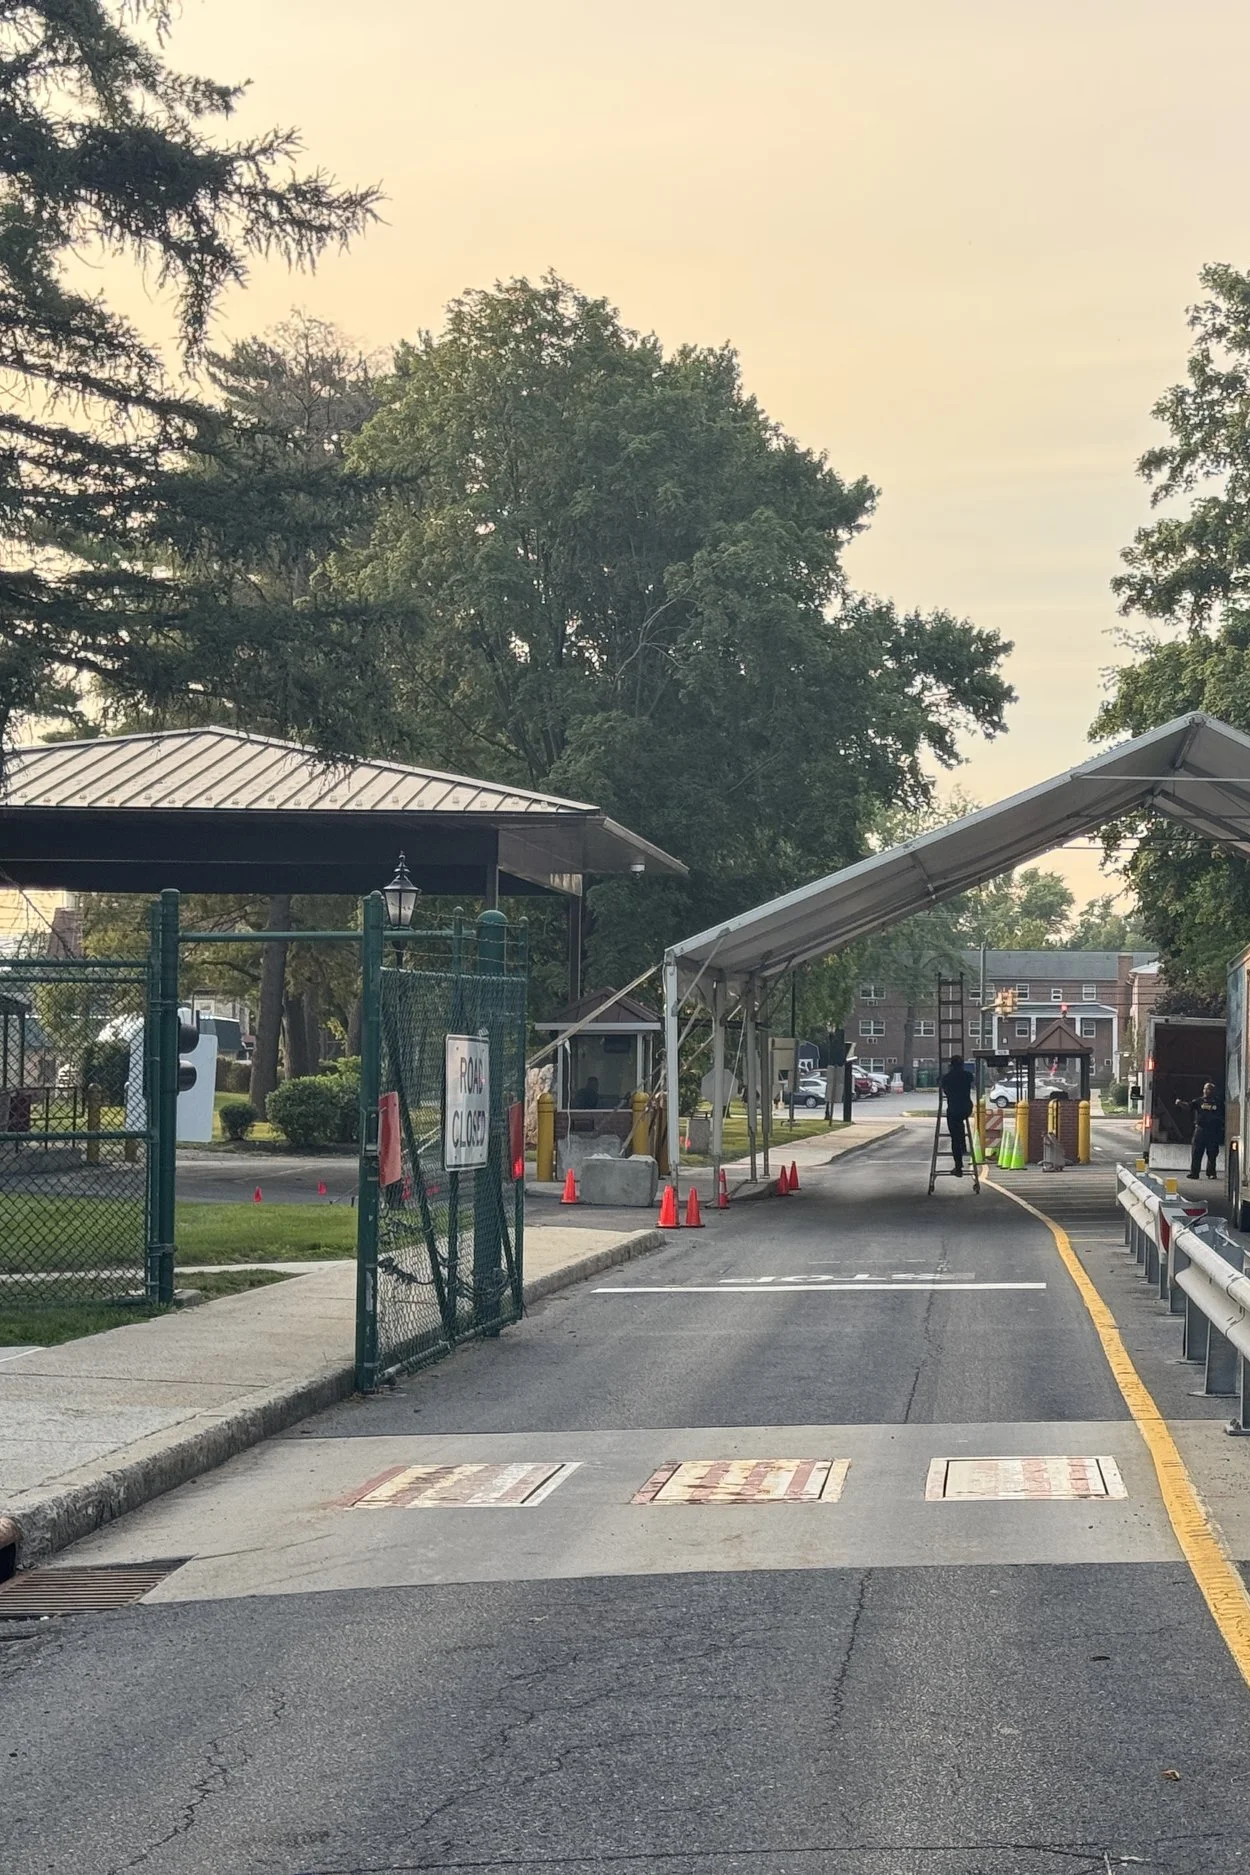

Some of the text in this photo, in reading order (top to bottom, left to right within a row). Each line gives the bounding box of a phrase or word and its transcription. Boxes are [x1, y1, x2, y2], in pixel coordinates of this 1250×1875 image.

[459, 1056, 484, 1095] ROAD
[452, 1110, 486, 1148] CLOSED
[718, 1272, 944, 1283] STOP
